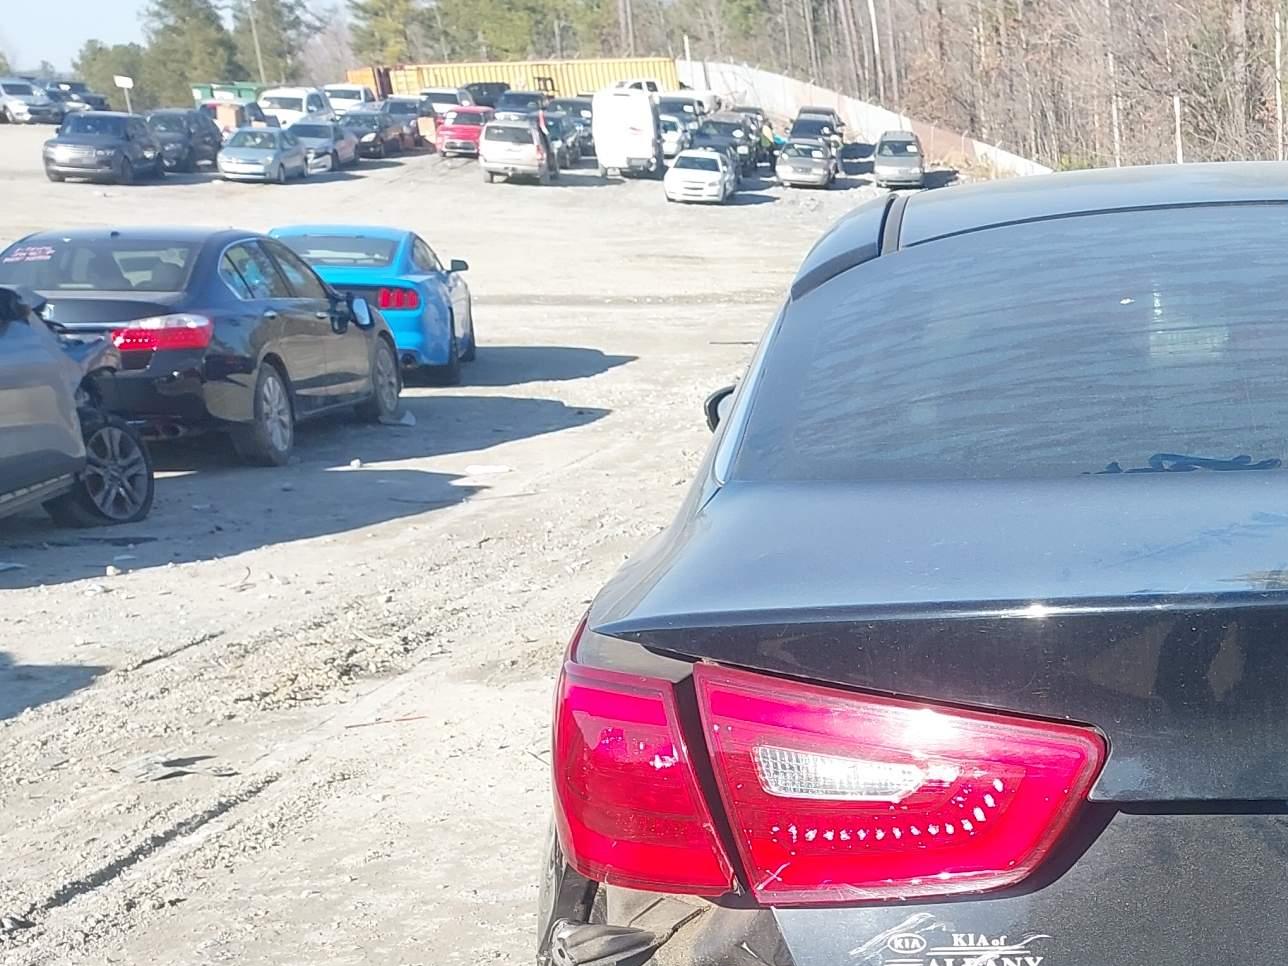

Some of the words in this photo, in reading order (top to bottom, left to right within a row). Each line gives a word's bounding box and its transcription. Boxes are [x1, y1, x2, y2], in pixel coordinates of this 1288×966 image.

[893, 937, 921, 950] KIA
[952, 933, 989, 947] KIA
[991, 935, 1008, 947] of
